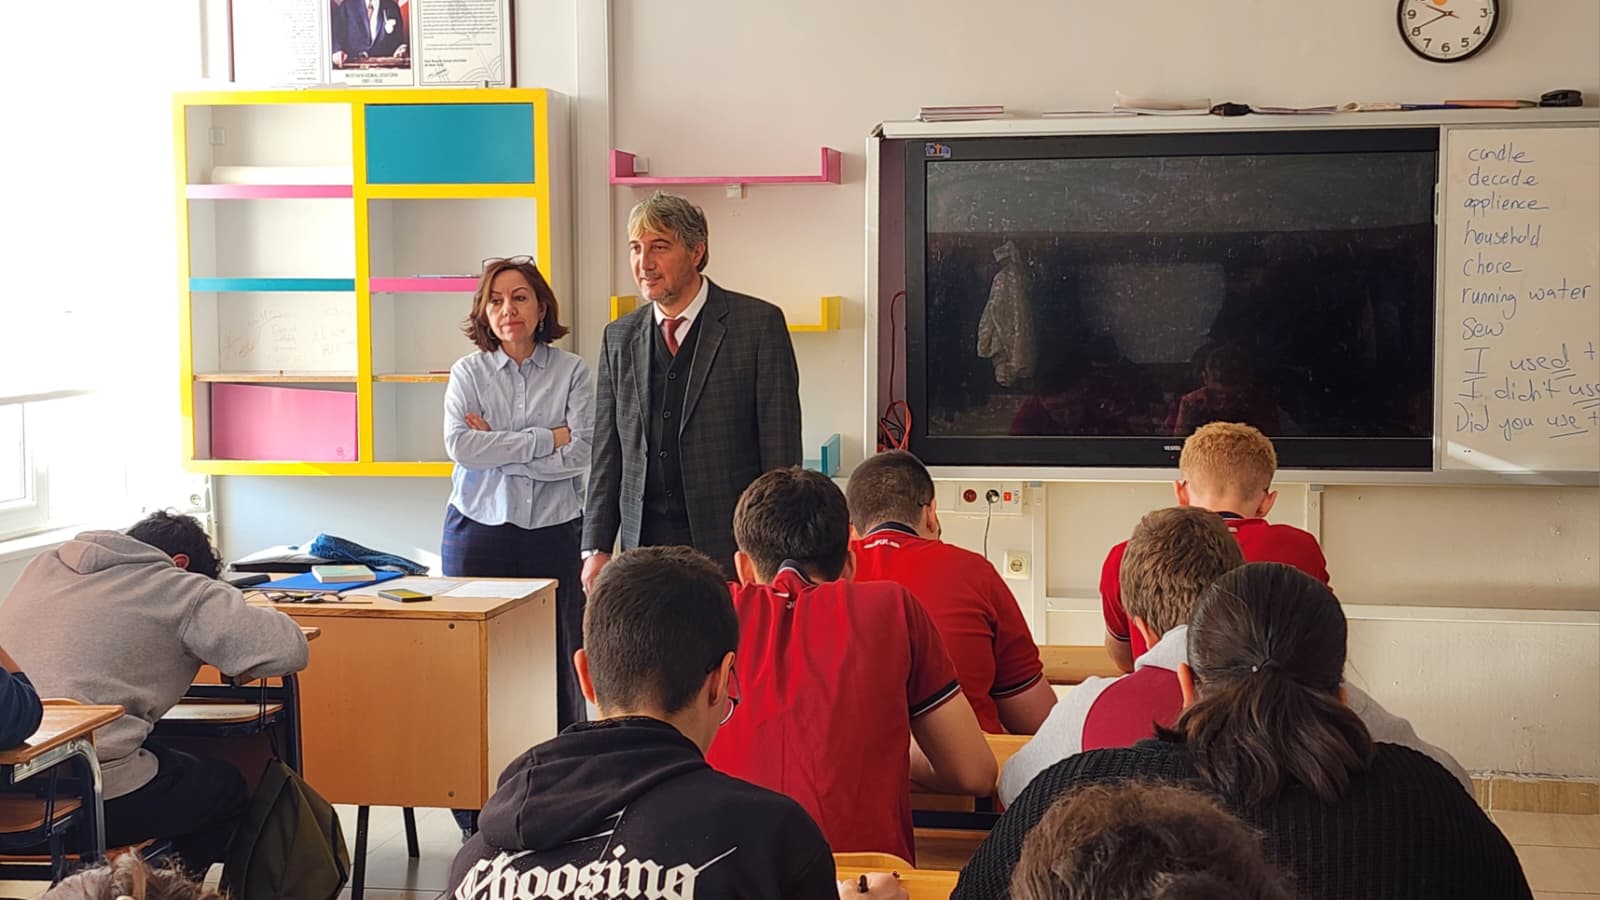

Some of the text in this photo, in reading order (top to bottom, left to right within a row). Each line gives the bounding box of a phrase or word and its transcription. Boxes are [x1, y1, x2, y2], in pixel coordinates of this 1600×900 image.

[1407, 9, 1417, 19] 9
[1480, 8, 1488, 18] 3
[1411, 27, 1421, 37] 8
[1473, 26, 1481, 35] 4
[1423, 38, 1432, 48] 7
[1441, 42, 1451, 52] 6
[1461, 38, 1470, 48] 5
[1468, 142, 1535, 164] candle
[1468, 167, 1539, 186] decade
[1464, 220, 1541, 248] household
[1462, 277, 1592, 320] running water
[1464, 346, 1491, 375] I
[1510, 343, 1569, 372] used
[1454, 402, 1490, 433] Did
[1499, 418, 1535, 441] you
[1547, 413, 1582, 429] use
[455, 844, 700, 900] Choosing
